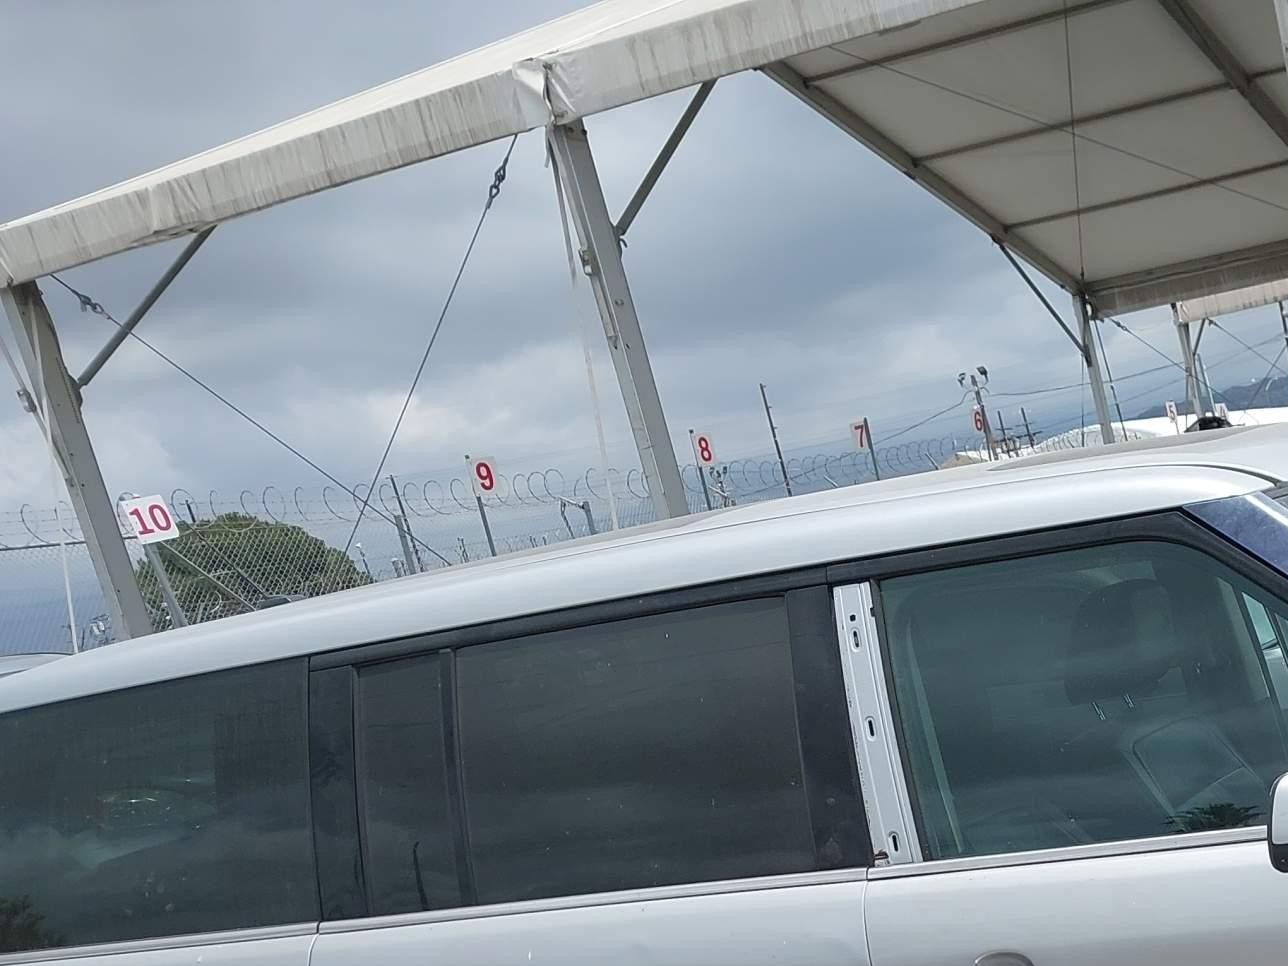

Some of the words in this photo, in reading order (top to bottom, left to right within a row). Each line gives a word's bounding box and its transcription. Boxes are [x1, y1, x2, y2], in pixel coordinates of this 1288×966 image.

[974, 411, 983, 431] 6
[698, 436, 712, 462] 8
[854, 424, 865, 448] 7
[475, 462, 494, 490] 9
[129, 504, 172, 535] 10
